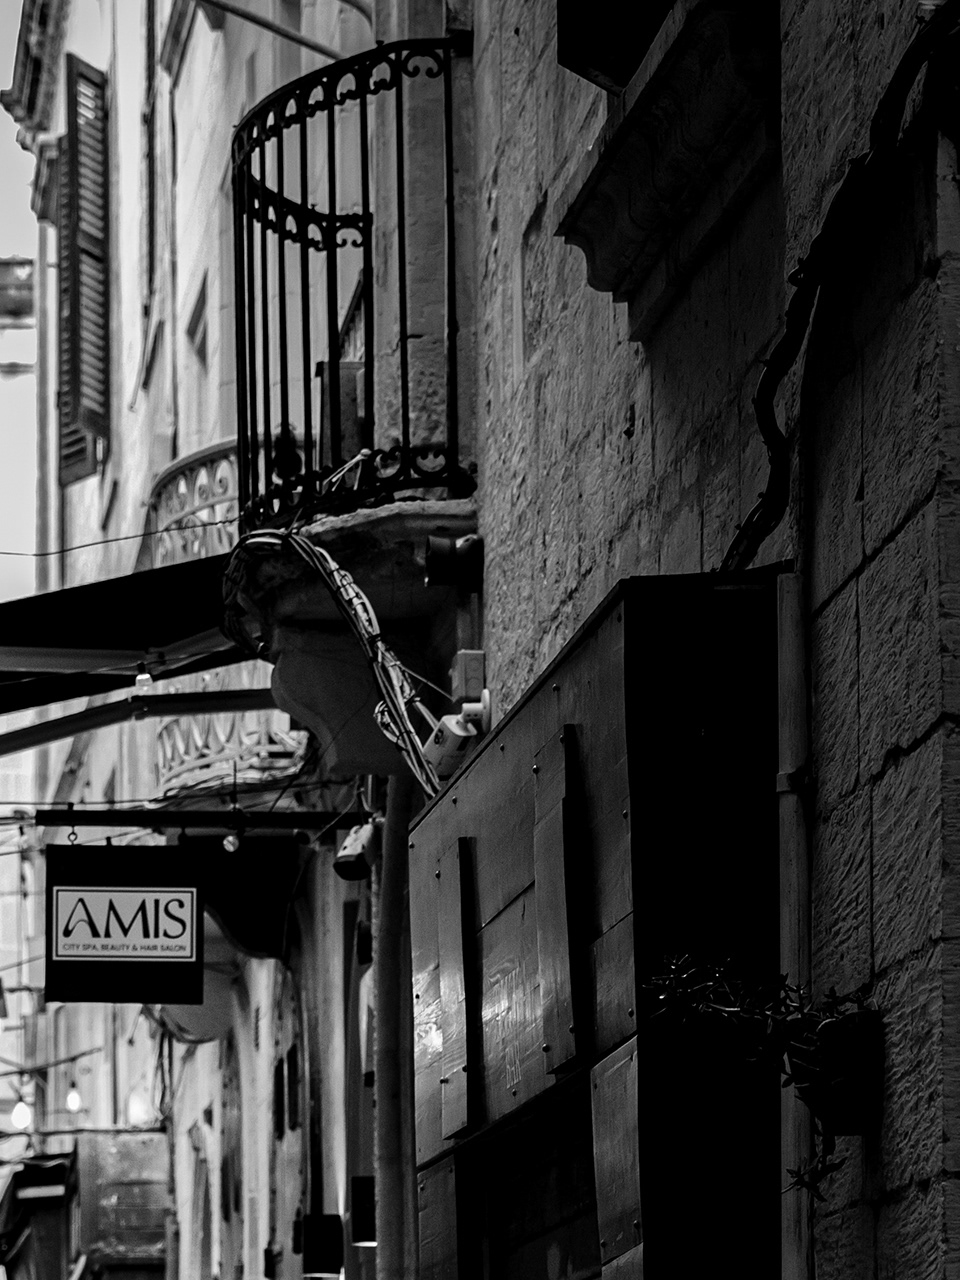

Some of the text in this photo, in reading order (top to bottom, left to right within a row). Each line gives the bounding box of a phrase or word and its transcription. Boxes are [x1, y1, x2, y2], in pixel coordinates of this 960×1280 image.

[62, 897, 187, 939] AMIS
[62, 943, 80, 951] CITY
[100, 944, 130, 952] BEAUTY
[131, 944, 139, 952] &
[140, 944, 158, 952] HAIR
[160, 944, 186, 953] SALON
